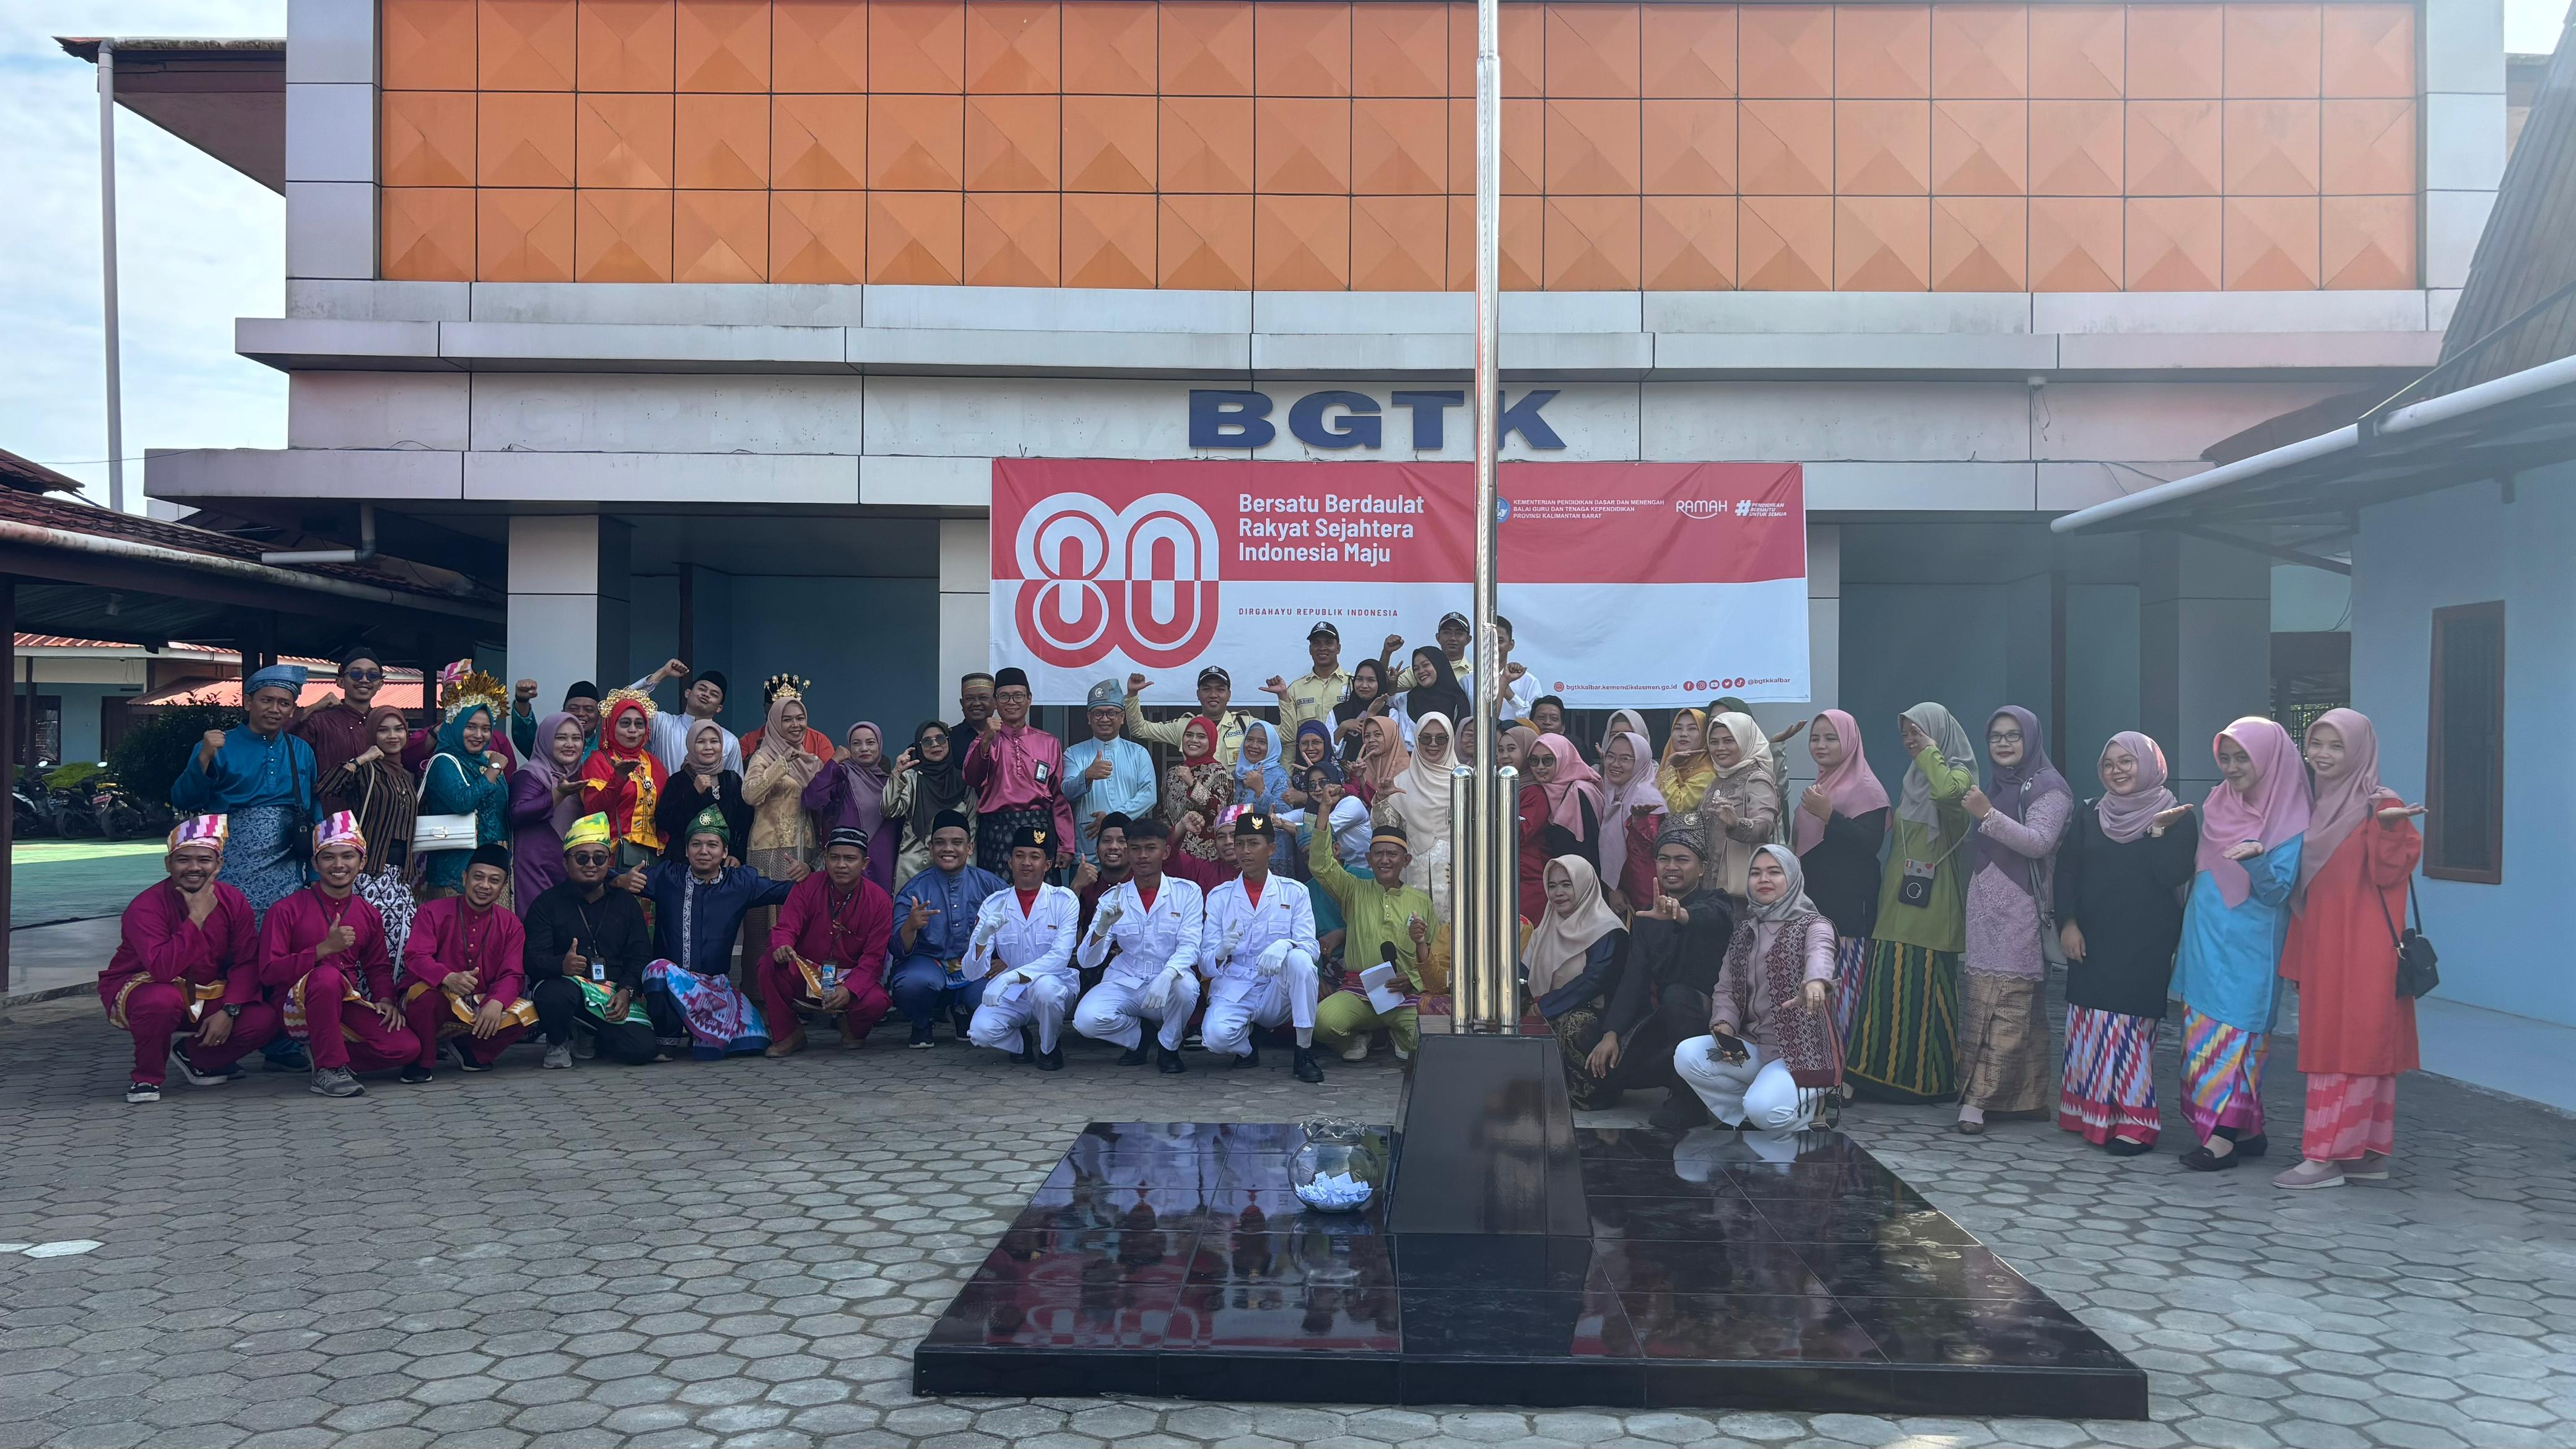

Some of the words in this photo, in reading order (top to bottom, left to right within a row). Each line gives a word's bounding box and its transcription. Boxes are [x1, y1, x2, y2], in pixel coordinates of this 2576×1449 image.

[1189, 389, 1567, 450] BGTK
[1239, 494, 1319, 513] Bersatu
[1325, 494, 1424, 513] Berdaulat
[1676, 500, 1728, 519] RAMAH
[1239, 518, 1310, 542] Rakyat
[1315, 518, 1414, 542] Sejahtera
[1239, 542, 1338, 562] Indonesia
[1344, 542, 1390, 567] Maju
[1015, 492, 1219, 669] 80
[1347, 609, 1398, 617] INDONESIA
[1747, 677, 1790, 685] @bgtkkalbar
